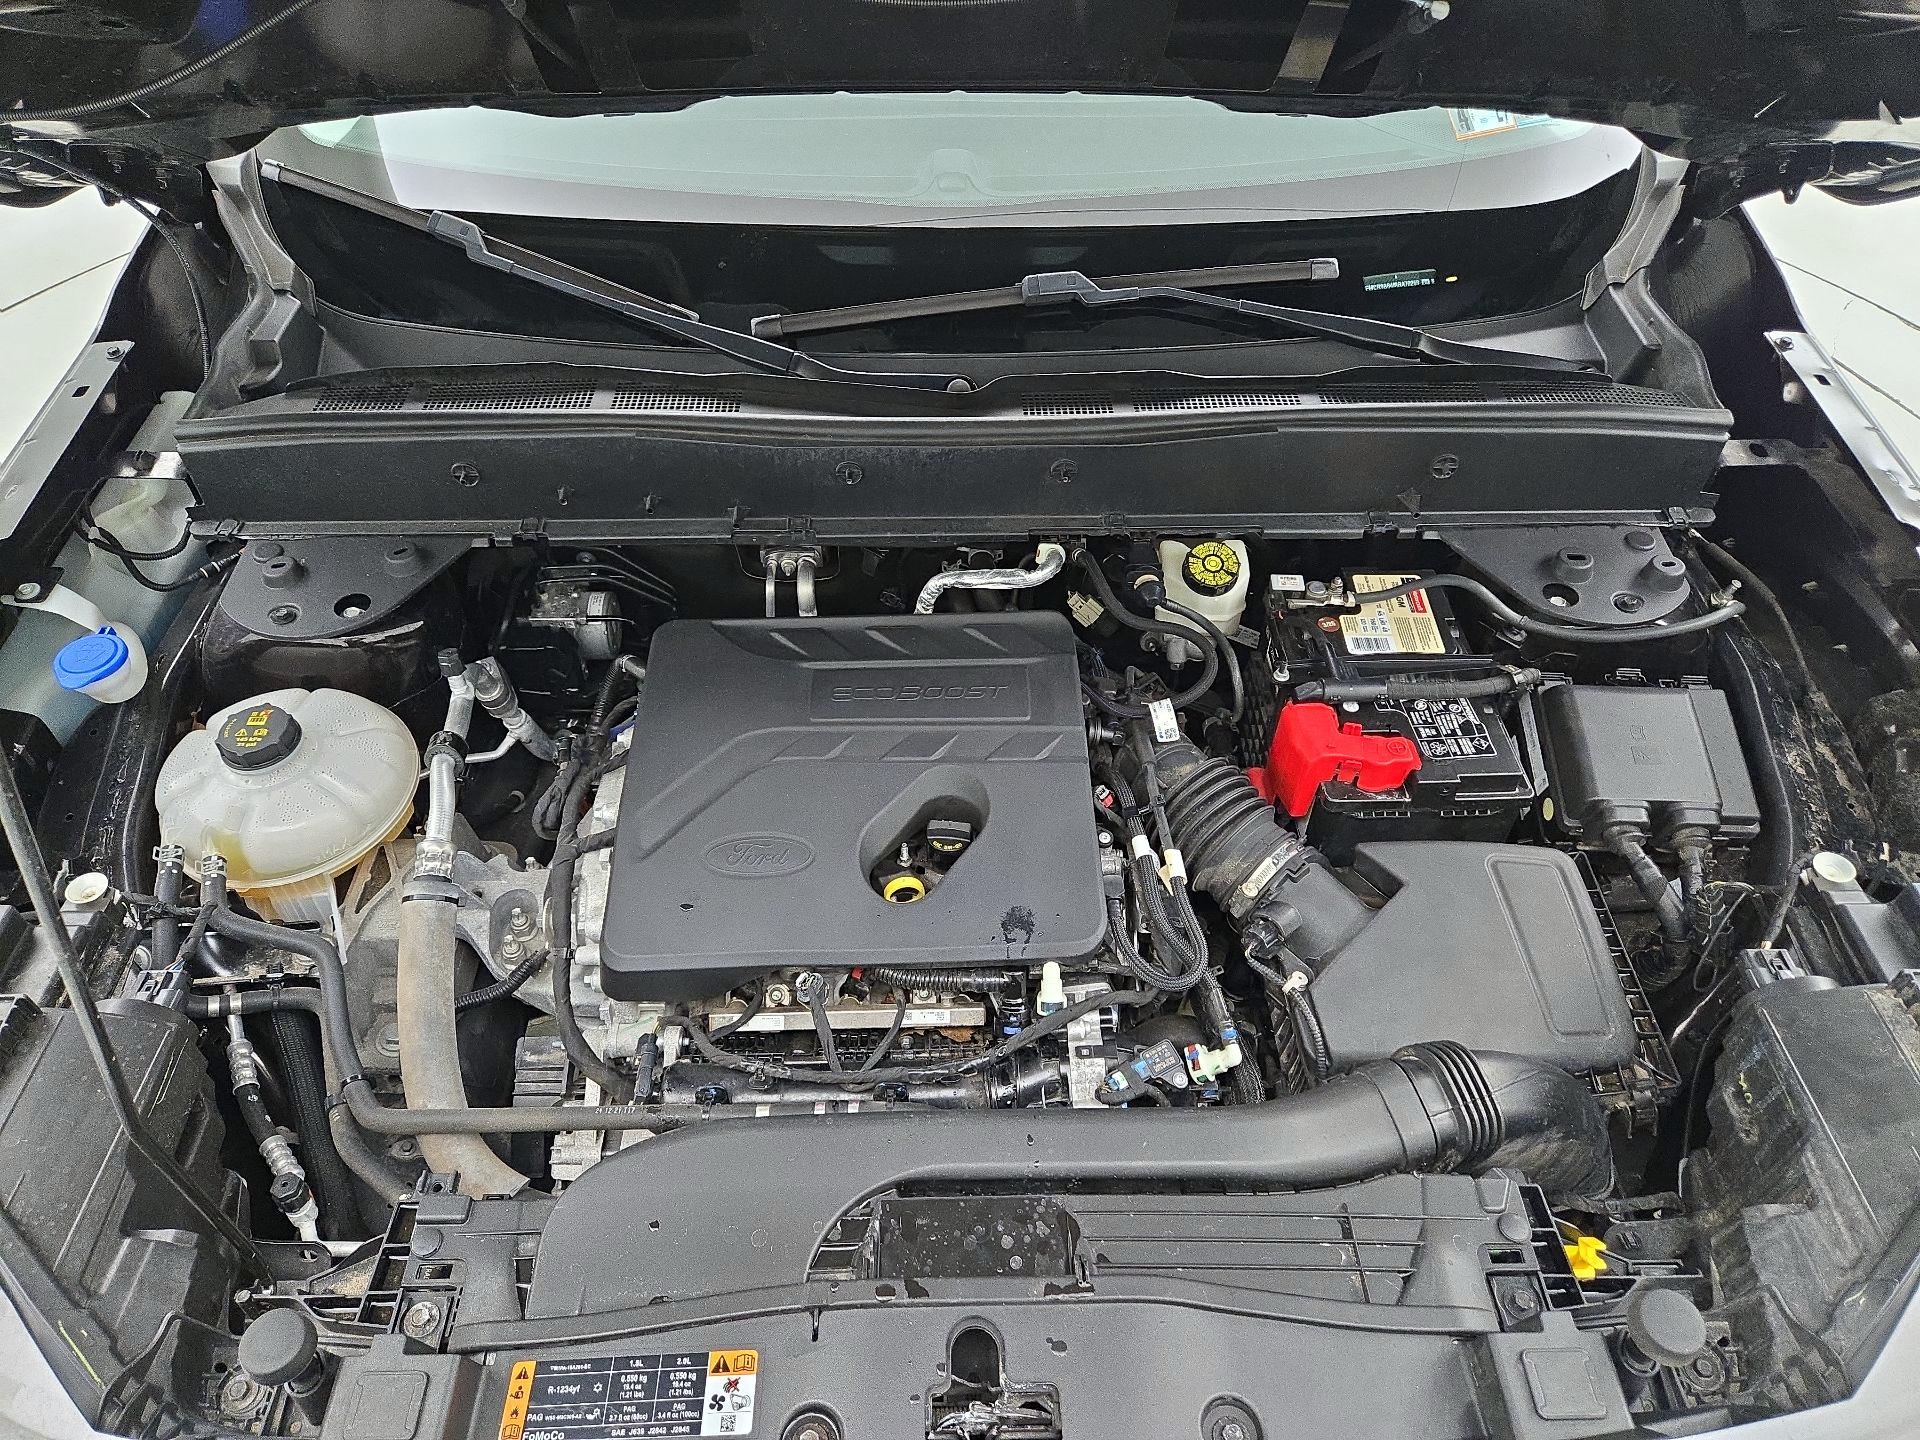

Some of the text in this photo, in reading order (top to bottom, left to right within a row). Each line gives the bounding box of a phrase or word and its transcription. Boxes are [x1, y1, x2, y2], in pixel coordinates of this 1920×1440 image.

[831, 685, 1010, 703] ECOBOOST
[726, 840, 791, 867] Ford
[676, 1357, 691, 1365] 2.0L
[639, 1375, 648, 1383] kg
[688, 1372, 697, 1381] kg
[548, 1385, 580, 1395] R-1234yf
[526, 1414, 543, 1422] PAG
[522, 1430, 565, 1440] FoMoCo
